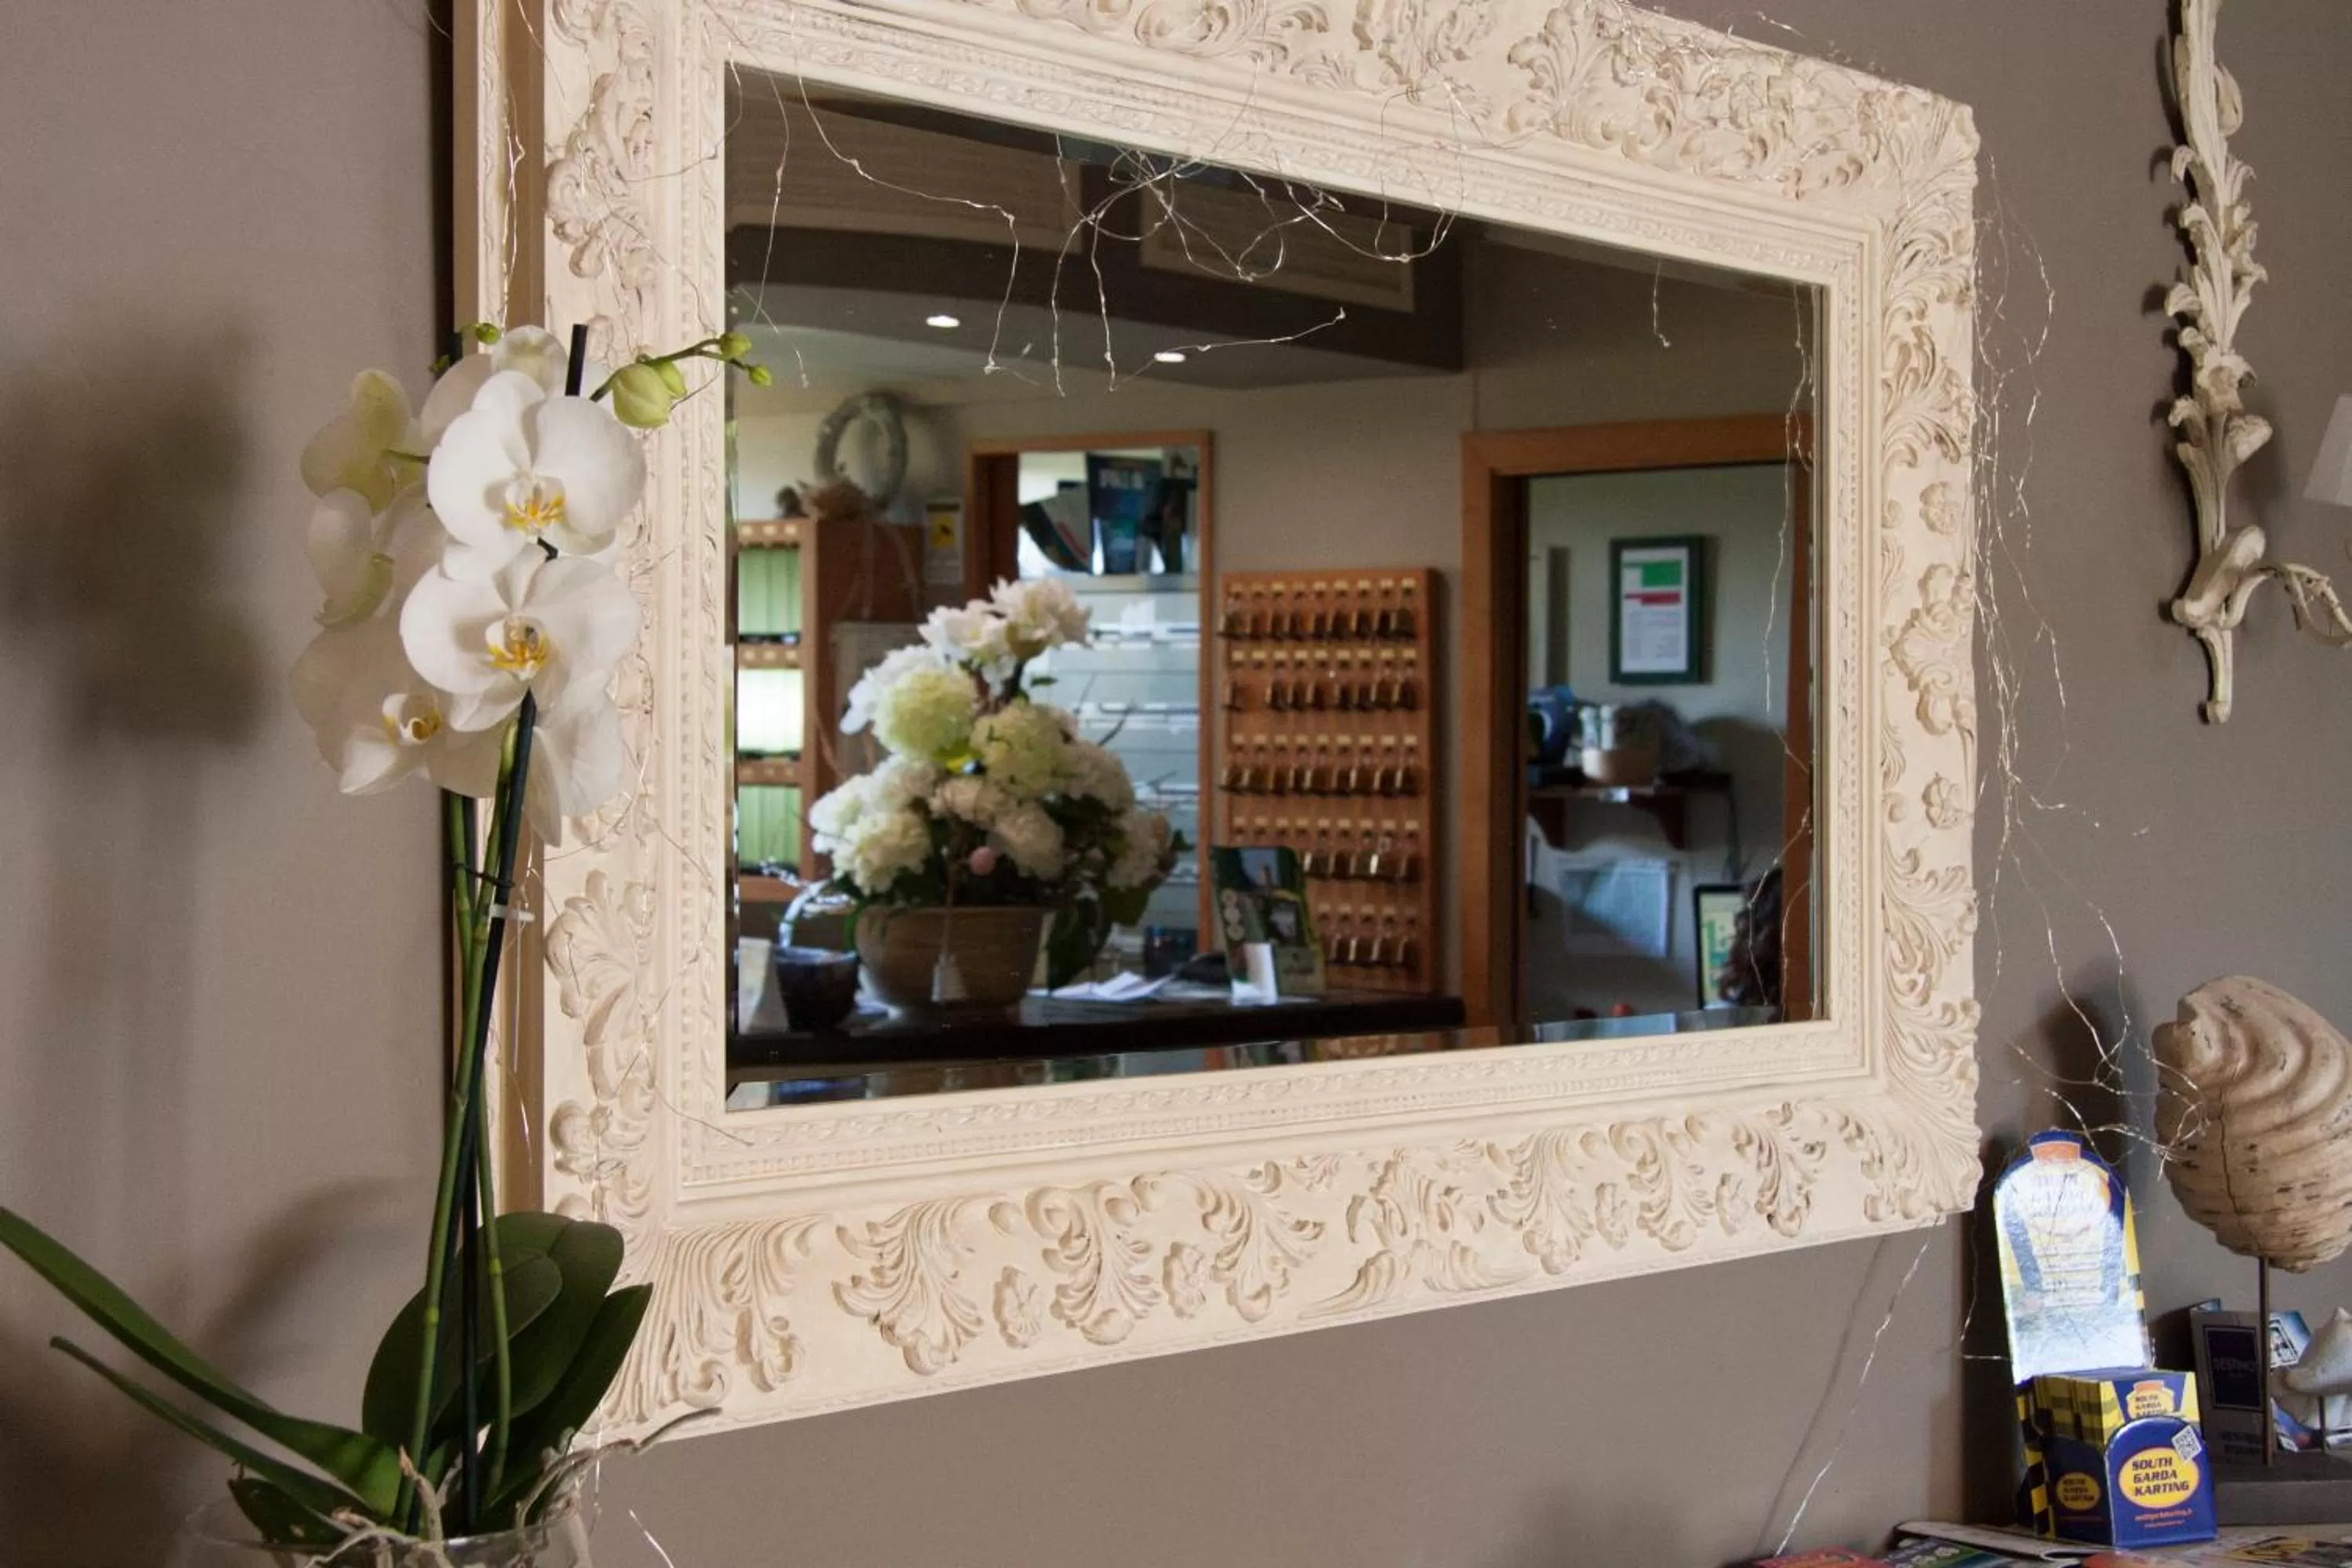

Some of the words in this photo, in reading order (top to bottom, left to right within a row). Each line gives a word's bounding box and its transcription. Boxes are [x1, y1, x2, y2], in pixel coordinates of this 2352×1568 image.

[2132, 1457, 2172, 1471] SOUTH
[2133, 1470, 2178, 1484] GARDA
[2135, 1480, 2189, 1497] KARTING
